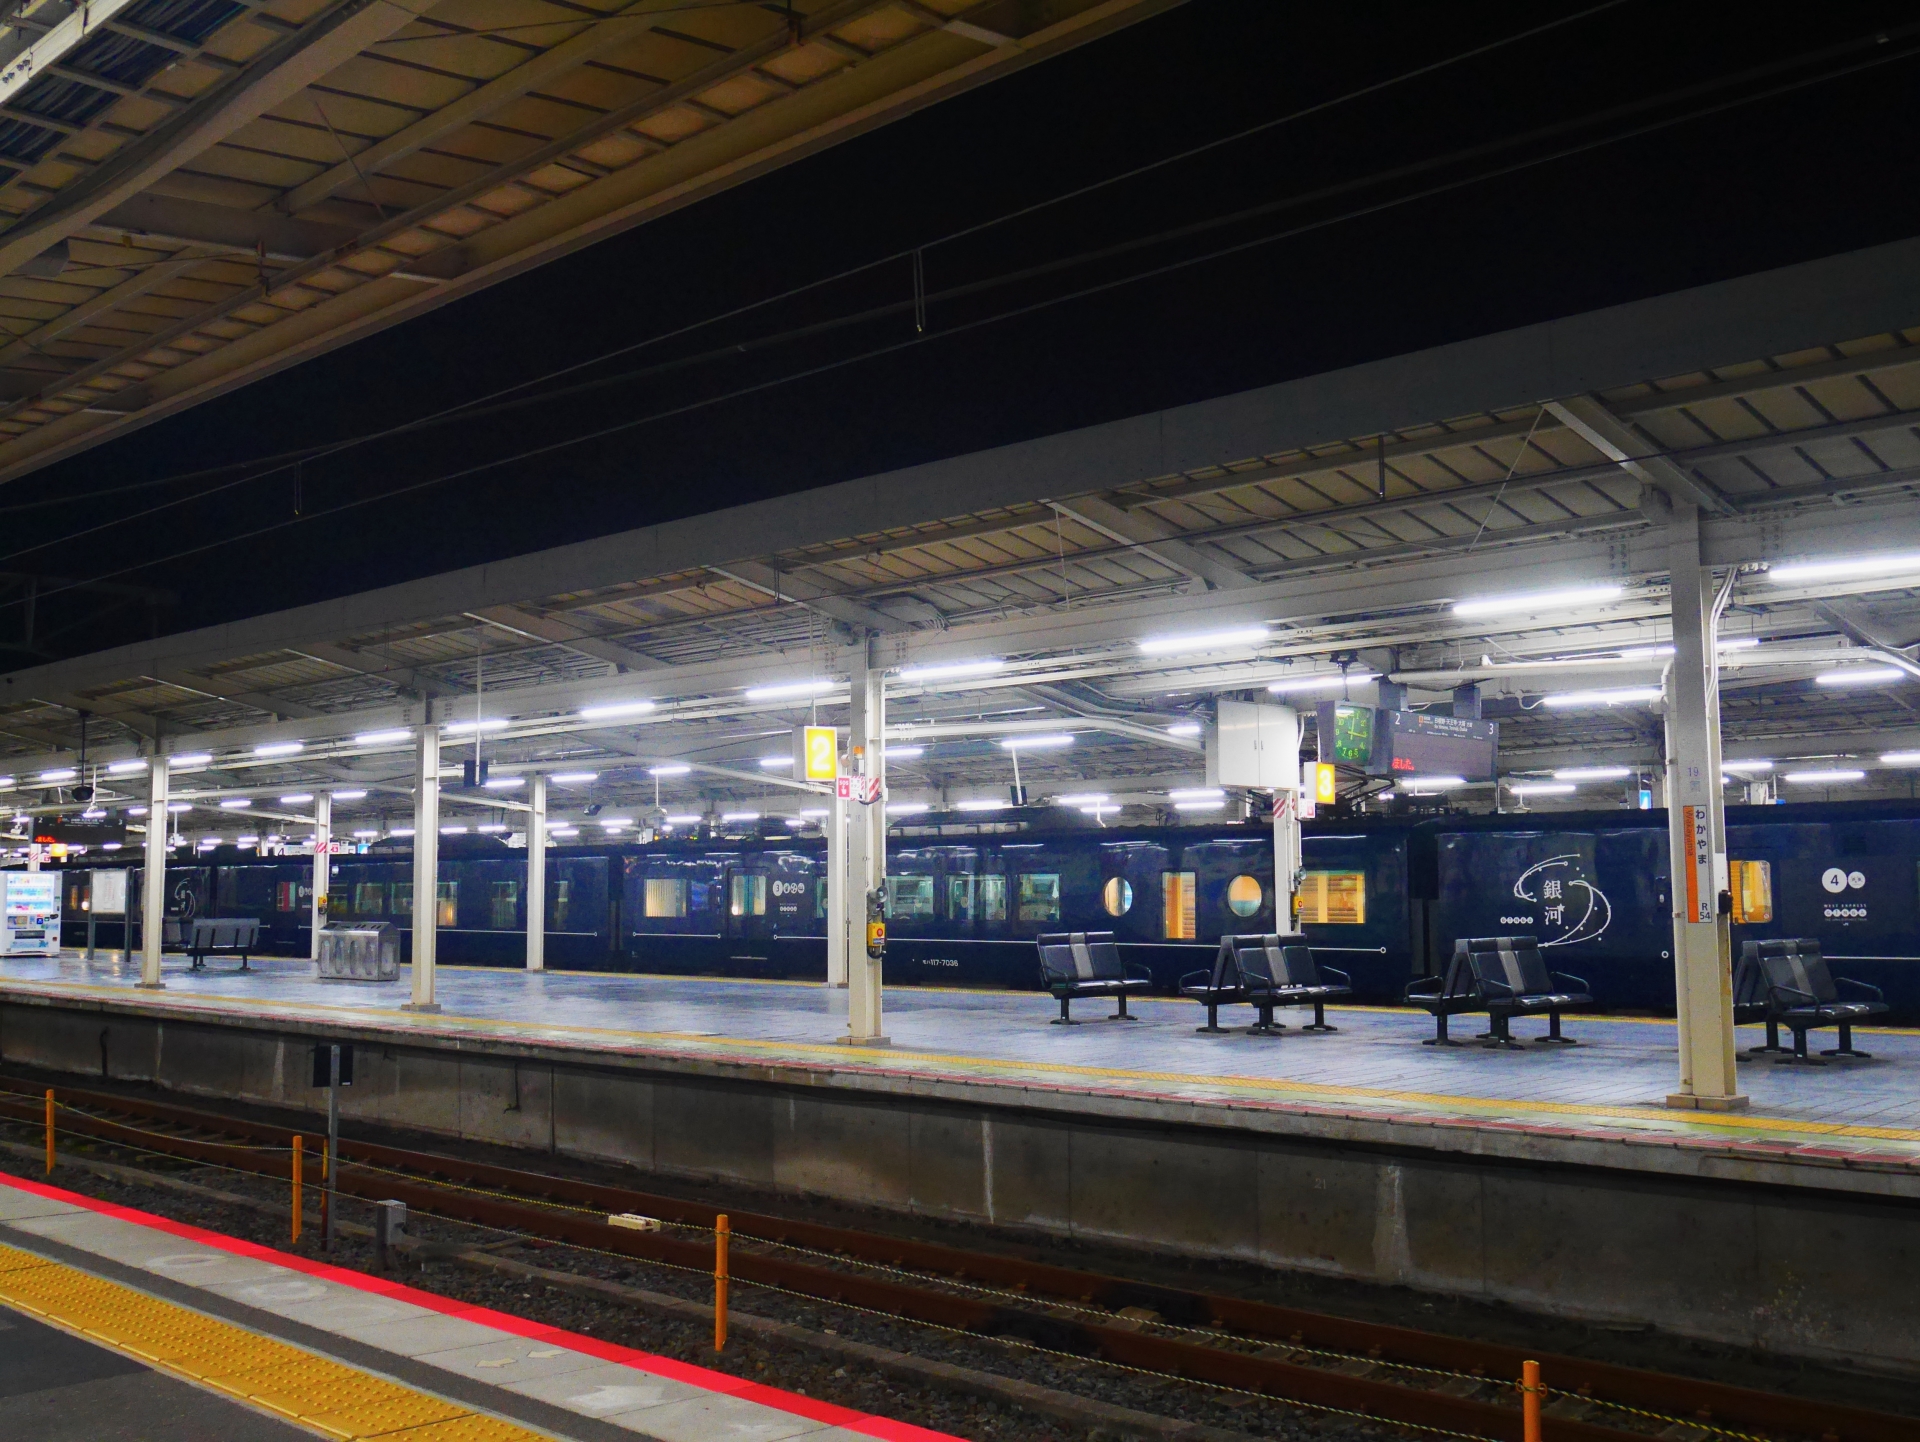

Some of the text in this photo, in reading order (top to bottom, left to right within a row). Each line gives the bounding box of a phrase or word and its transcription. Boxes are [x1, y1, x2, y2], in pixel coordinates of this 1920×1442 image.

[1395, 713, 1401, 725] 2
[1488, 723, 1494, 735] 3
[811, 735, 831, 771] 2
[1687, 766, 1699, 777] 19
[1319, 769, 1332, 797] 3
[1685, 810, 1694, 856] Wakayama
[1695, 809, 1707, 865] わかやま
[1830, 874, 1839, 886] 4
[1543, 880, 1563, 925] 銀河
[1701, 902, 1708, 911] R
[1699, 911, 1711, 920] 54
